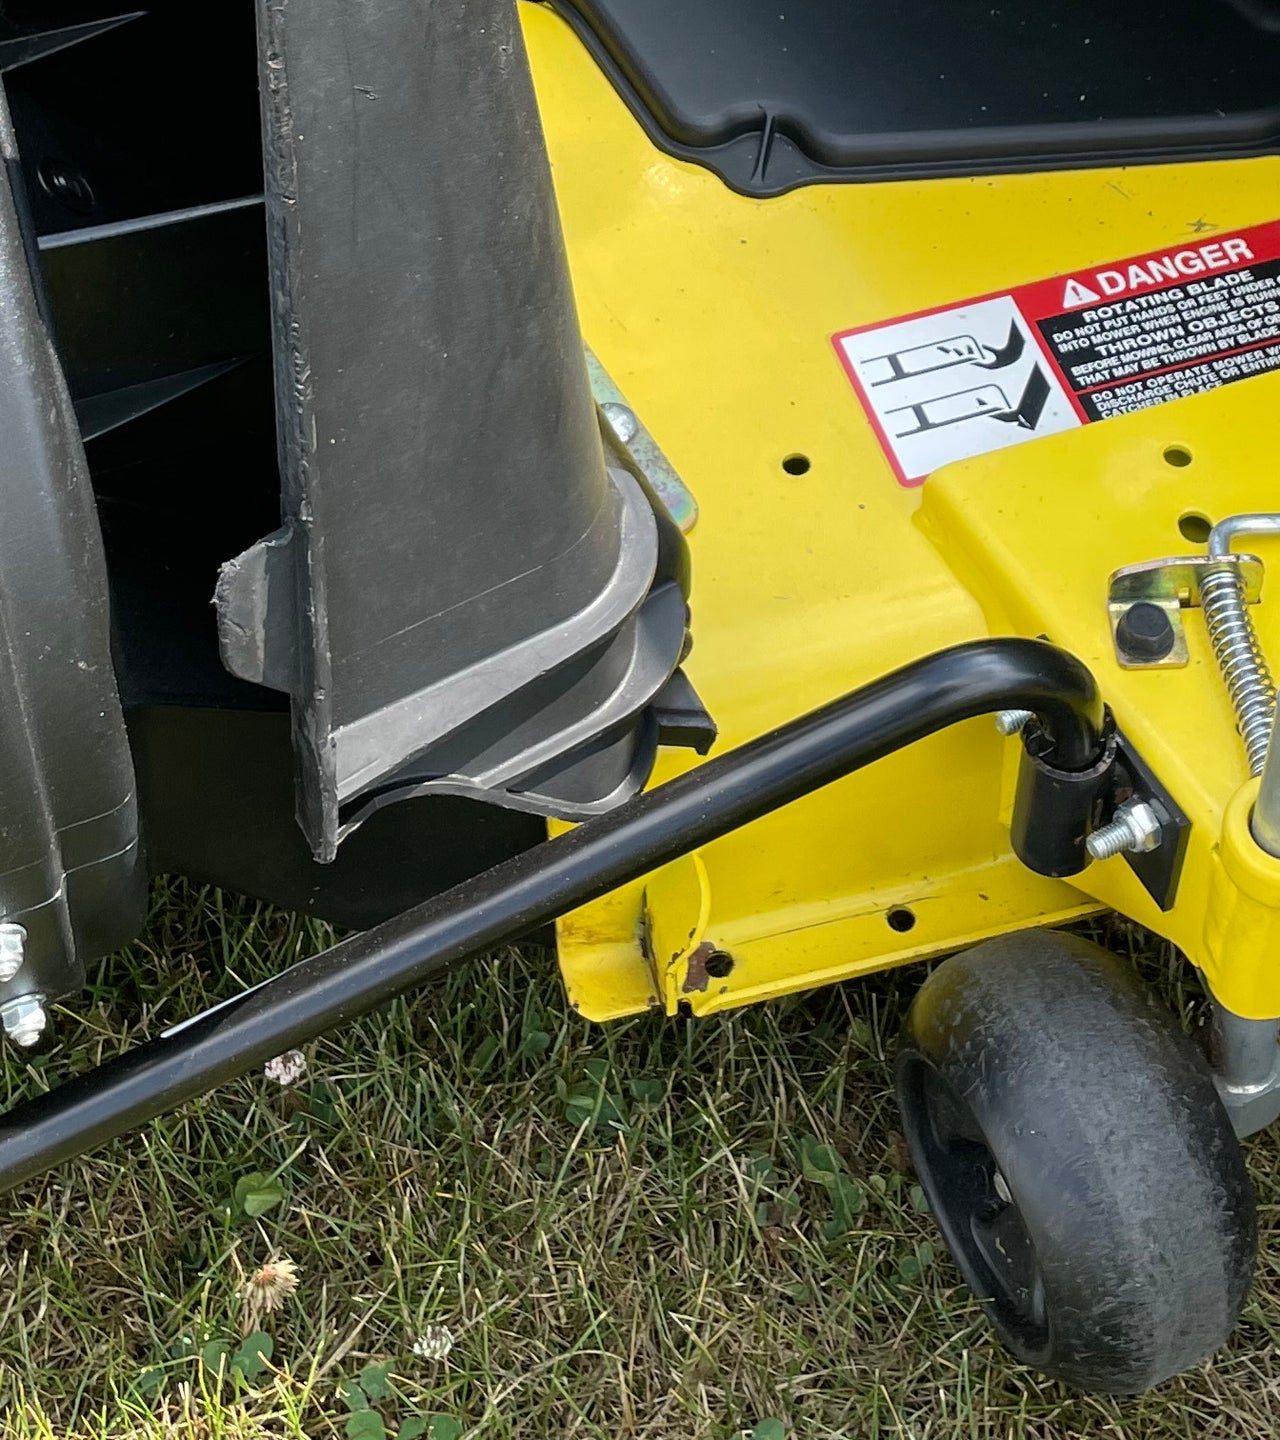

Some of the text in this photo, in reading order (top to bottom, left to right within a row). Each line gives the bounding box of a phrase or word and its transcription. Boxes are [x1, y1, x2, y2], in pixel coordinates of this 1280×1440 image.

[1096, 238, 1255, 296] DANGER
[1052, 330, 1073, 343] DO
[1074, 323, 1101, 337] NOT
[1103, 315, 1128, 329] PUT
[1130, 304, 1176, 322] HANDS
[1177, 298, 1197, 310] OR
[1197, 289, 1229, 305] FEET
[1231, 278, 1276, 296] UNDER
[1082, 270, 1254, 322] ROTATING BLADE
[1058, 338, 1089, 352] INTO
[1090, 324, 1141, 344] MOWER
[1141, 313, 1181, 330] WHEN
[1181, 301, 1230, 320] ENGINE
[1230, 297, 1245, 307] IS
[1071, 356, 1121, 376] BEFORE
[1120, 343, 1174, 363] MOWING,
[1173, 332, 1214, 349] CLEAR
[1214, 324, 1247, 338] AREA
[1246, 318, 1263, 330] OF
[1094, 301, 1279, 356] THROWN OBJECTS
[1076, 325, 1280, 385] THAT MAY BE THROWN BY BLADE
[1091, 391, 1112, 402] DO
[1114, 382, 1143, 396] NOT
[1146, 364, 1211, 388] OPERATE
[1212, 350, 1265, 370] MOWER
[1096, 384, 1173, 411] DISCHARGE
[1174, 372, 1218, 390] CHUTE
[1219, 367, 1240, 378] OR
[1101, 397, 1163, 419] CATCHER
